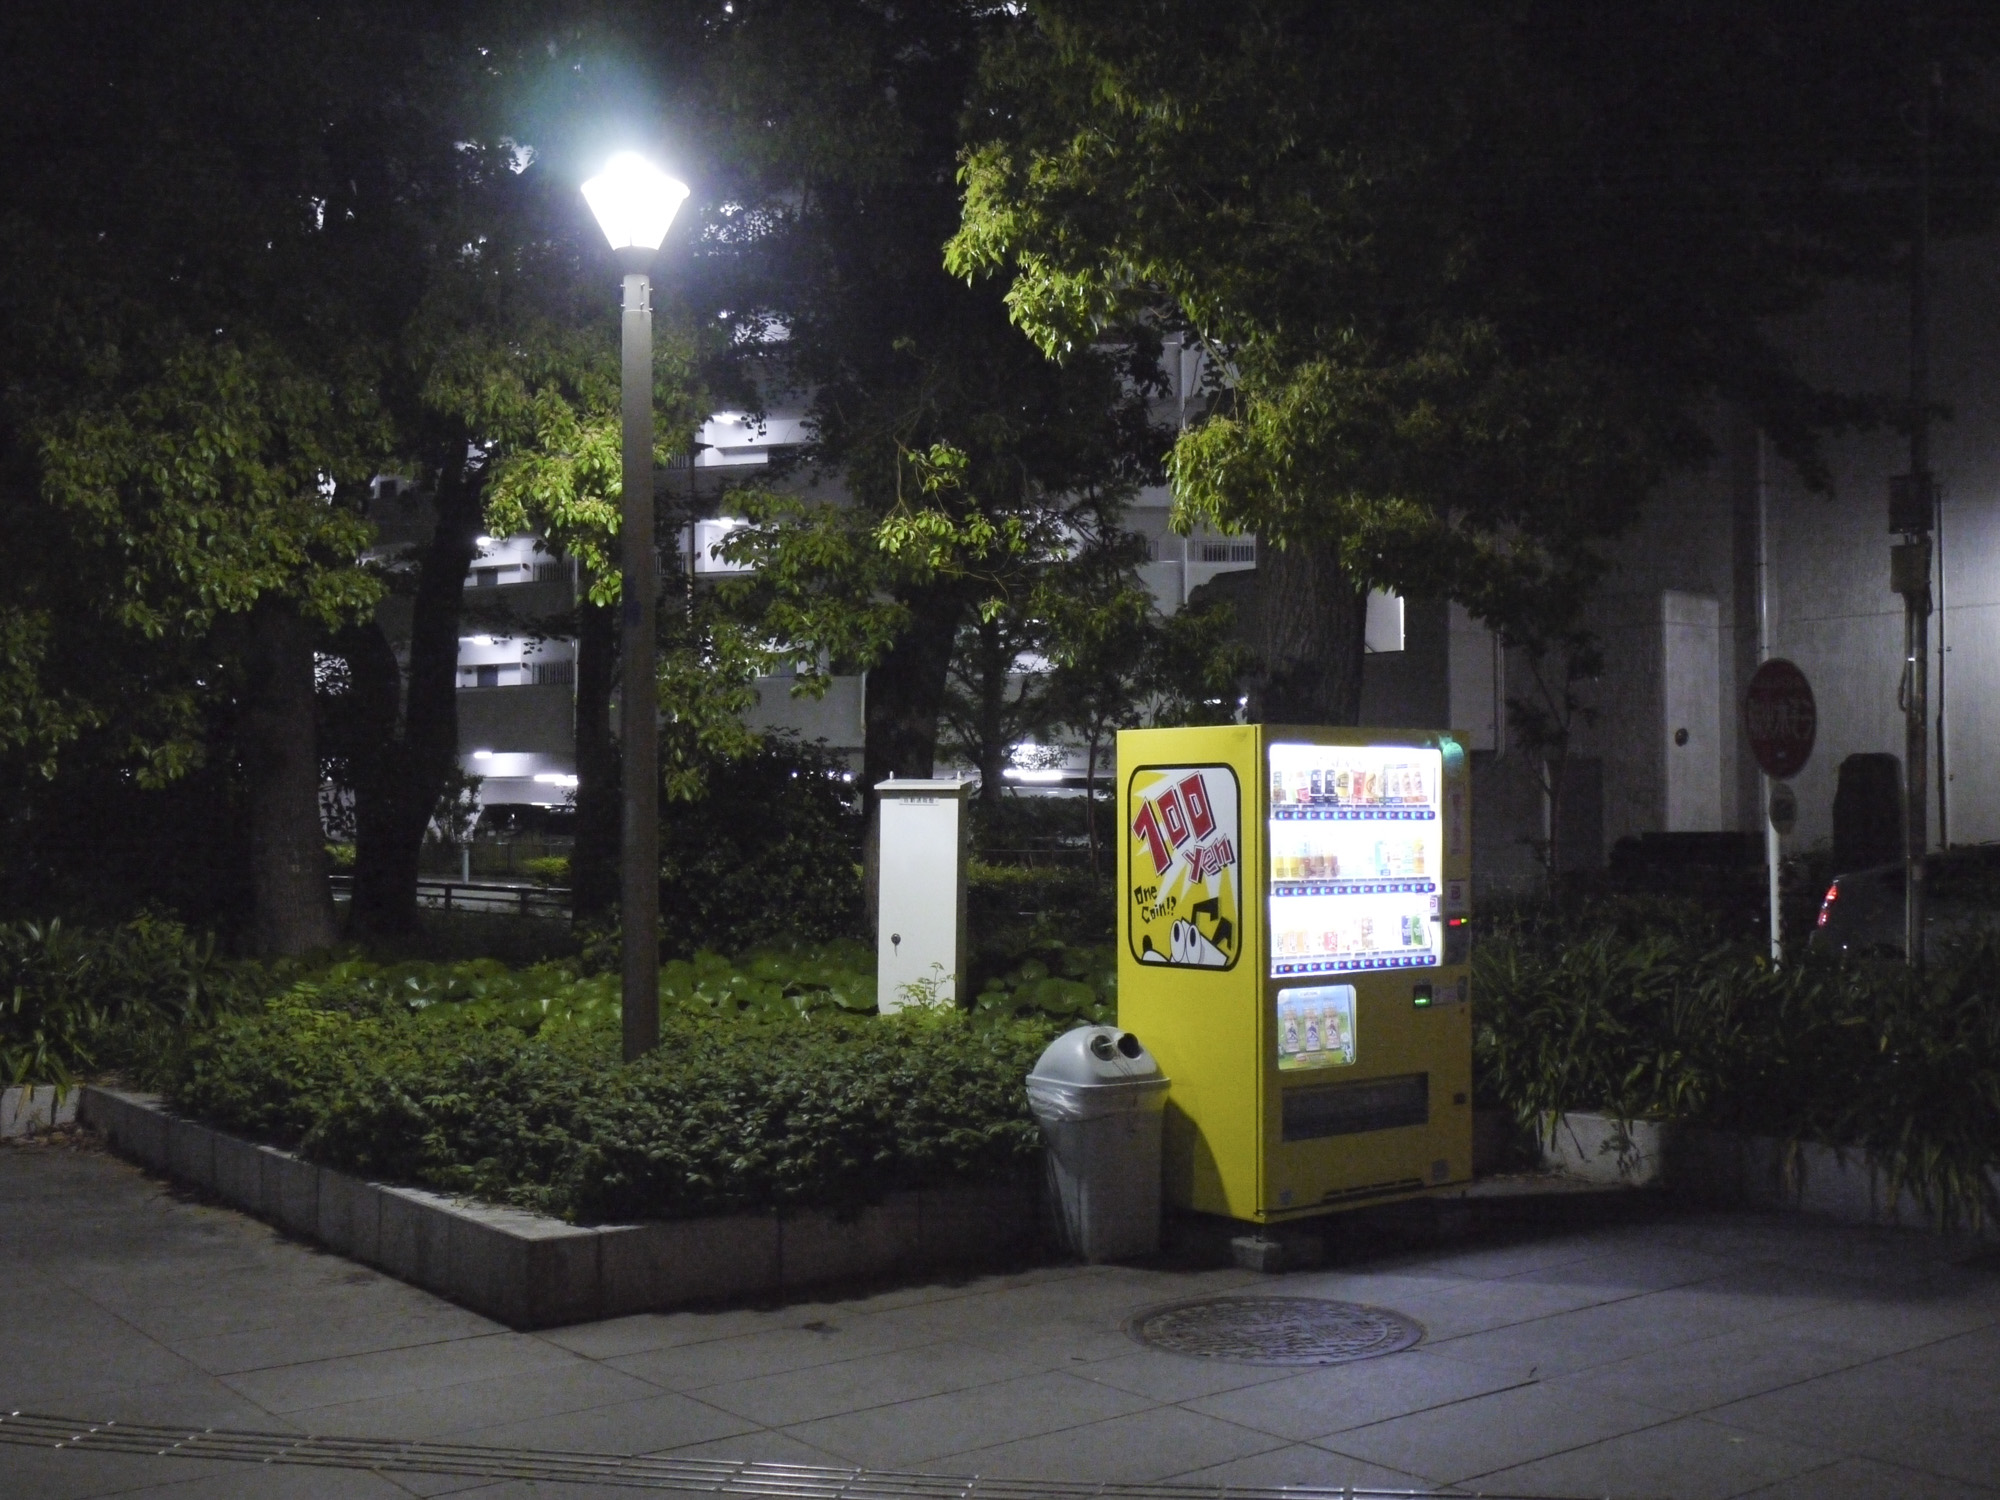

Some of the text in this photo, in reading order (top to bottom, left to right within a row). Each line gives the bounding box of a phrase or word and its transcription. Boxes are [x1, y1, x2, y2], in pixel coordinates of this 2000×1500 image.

[1132, 771, 1216, 877] 100
[1134, 885, 1157, 905] One
[1141, 896, 1177, 924] Coin!?
